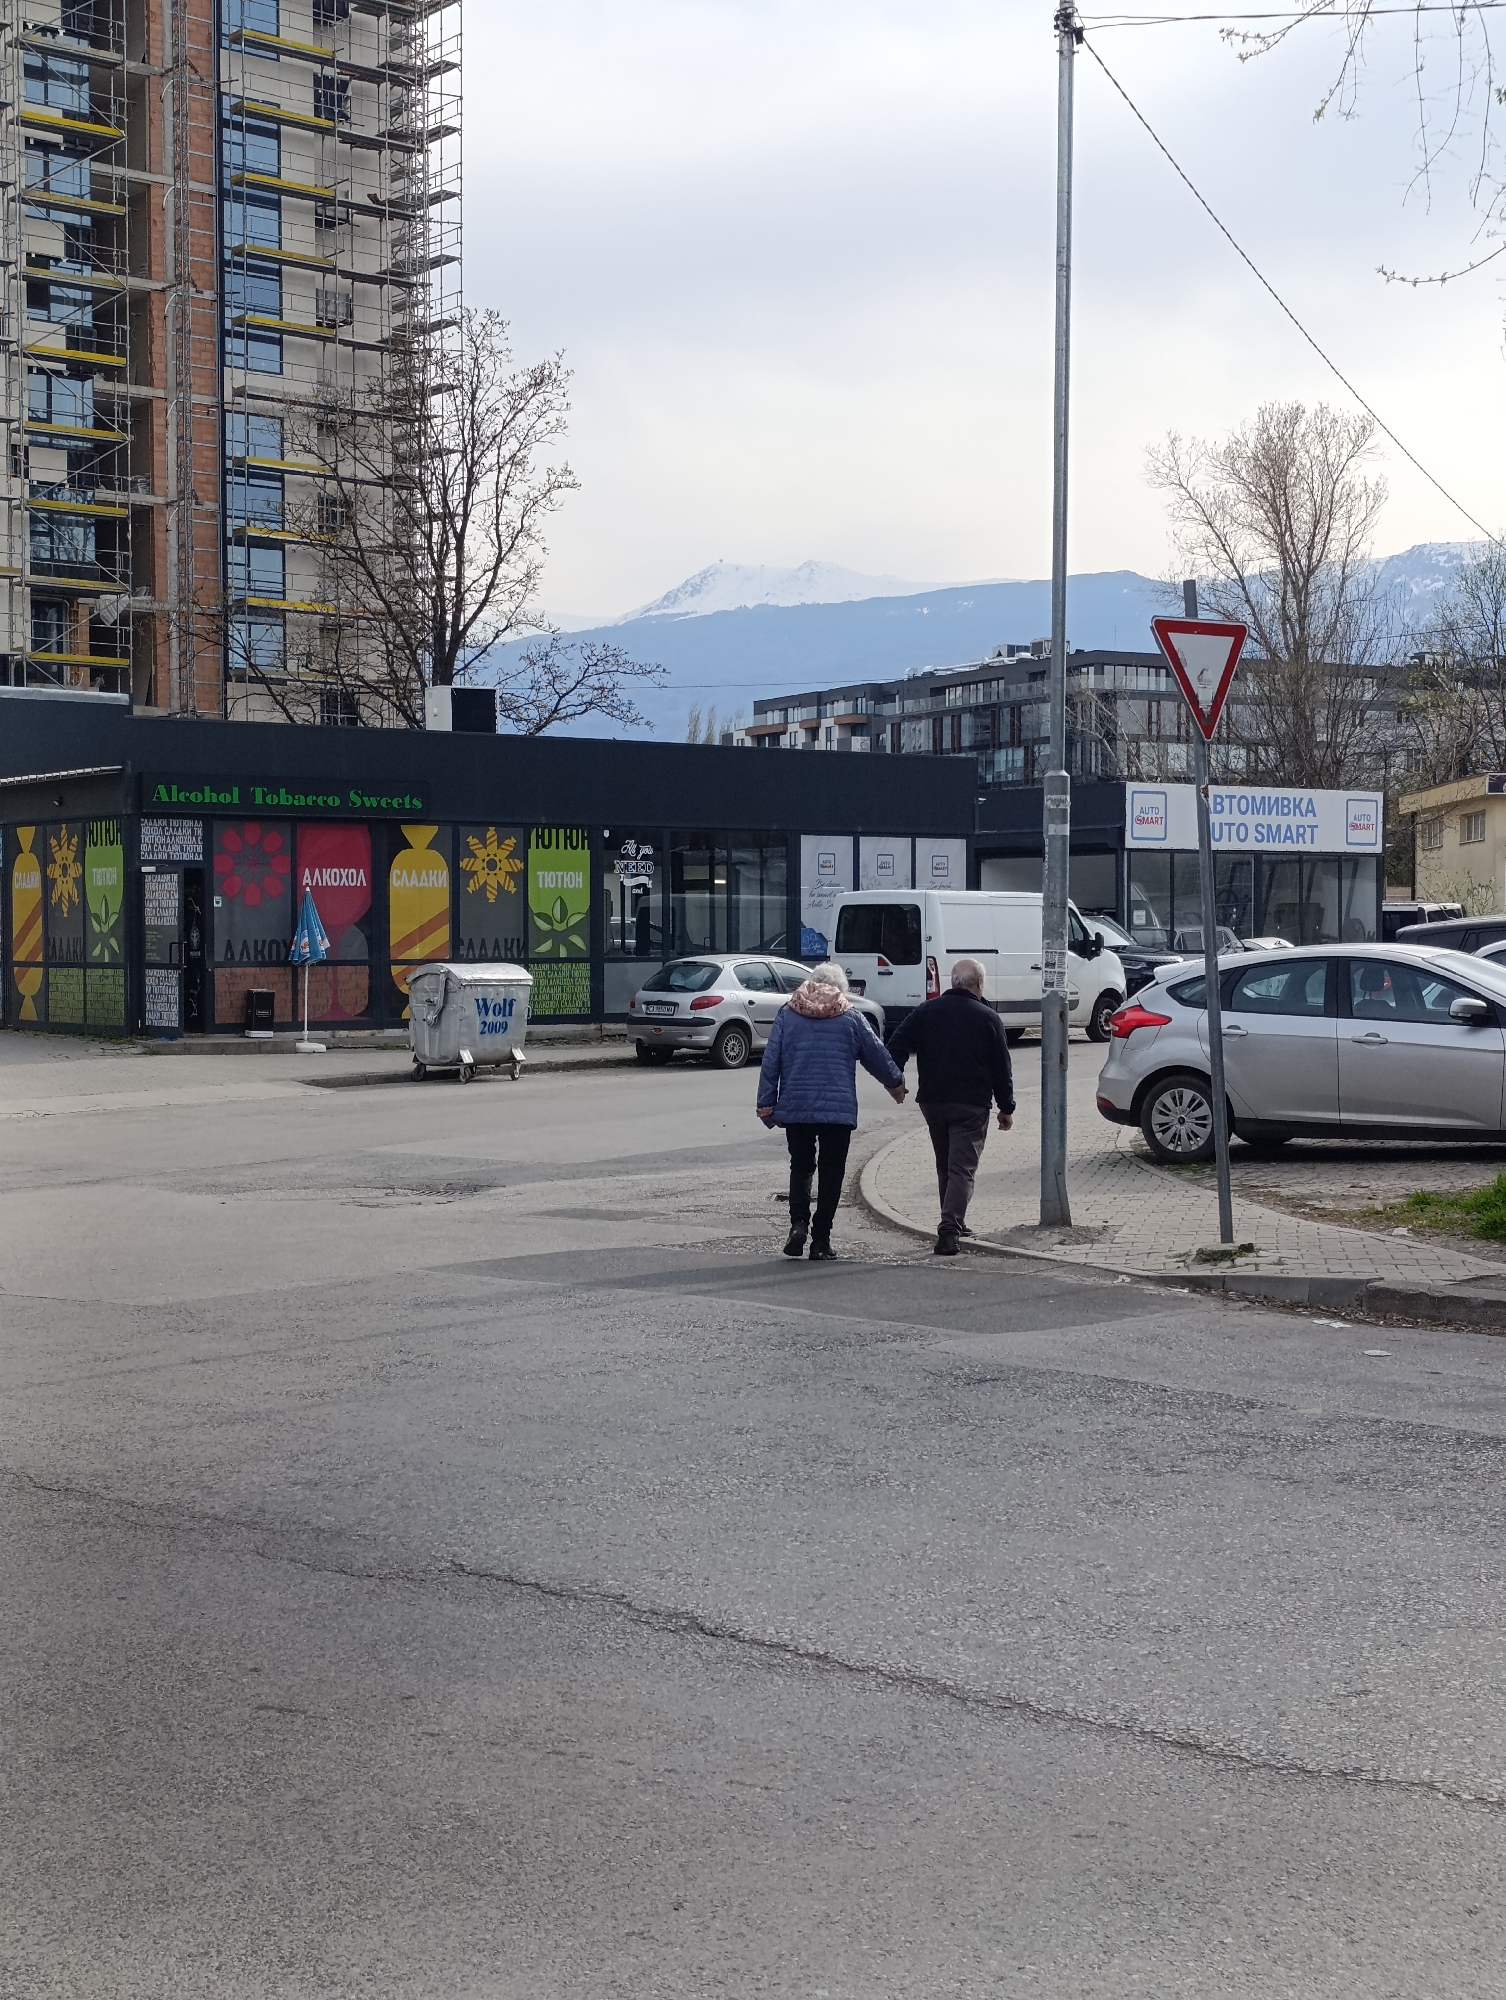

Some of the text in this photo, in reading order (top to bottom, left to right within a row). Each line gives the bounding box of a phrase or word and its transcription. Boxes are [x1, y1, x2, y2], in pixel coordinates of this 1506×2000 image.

[152, 785, 423, 810] Alcohol Tobacco Sweets
[1208, 794, 1317, 818] ВТОМИВКА
[1139, 806, 1160, 815] AUTO
[1353, 813, 1372, 822] AUTO
[1134, 815, 1164, 826] SMART
[1349, 821, 1375, 832] SMART
[1211, 822, 1319, 845] UTO SMART
[614, 860, 655, 875] NEED
[15, 871, 41, 889] СЛАДКИ
[93, 867, 118, 887] ТЮТЮН
[302, 867, 367, 887] АЛКОХОЛ
[392, 869, 448, 888] СЛАДКИ
[536, 871, 583, 889] ТЮТЮН
[474, 997, 517, 1018] Wolf
[479, 1020, 509, 1036] 2009
